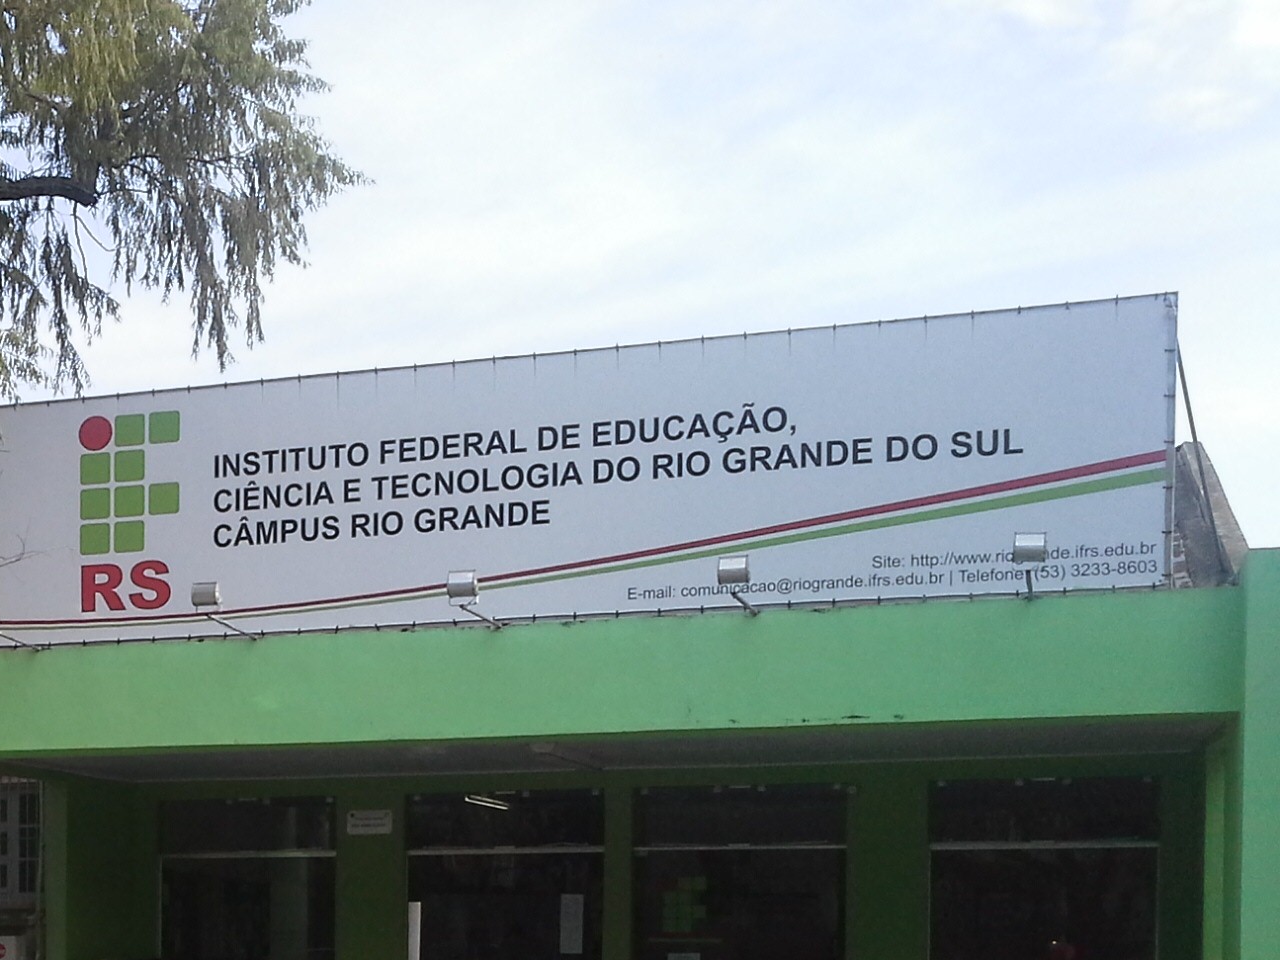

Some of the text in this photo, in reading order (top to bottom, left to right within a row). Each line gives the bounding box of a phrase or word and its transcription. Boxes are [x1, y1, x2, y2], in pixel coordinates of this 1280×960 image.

[213, 402, 796, 478] INSTITUTO FEDERAL DE EDUCAÇÃO,
[213, 428, 1024, 513] CIÊNCIA E TECNOLOGIA DO RIO GRANDE DO SUL
[213, 500, 551, 548] CÂMPUS RIO GRANDE
[81, 559, 172, 613] RS
[627, 585, 676, 600] E-mail:
[1034, 564, 1066, 582] (53)
[1070, 559, 1158, 577] 3233-8603
[871, 554, 905, 569] Site:
